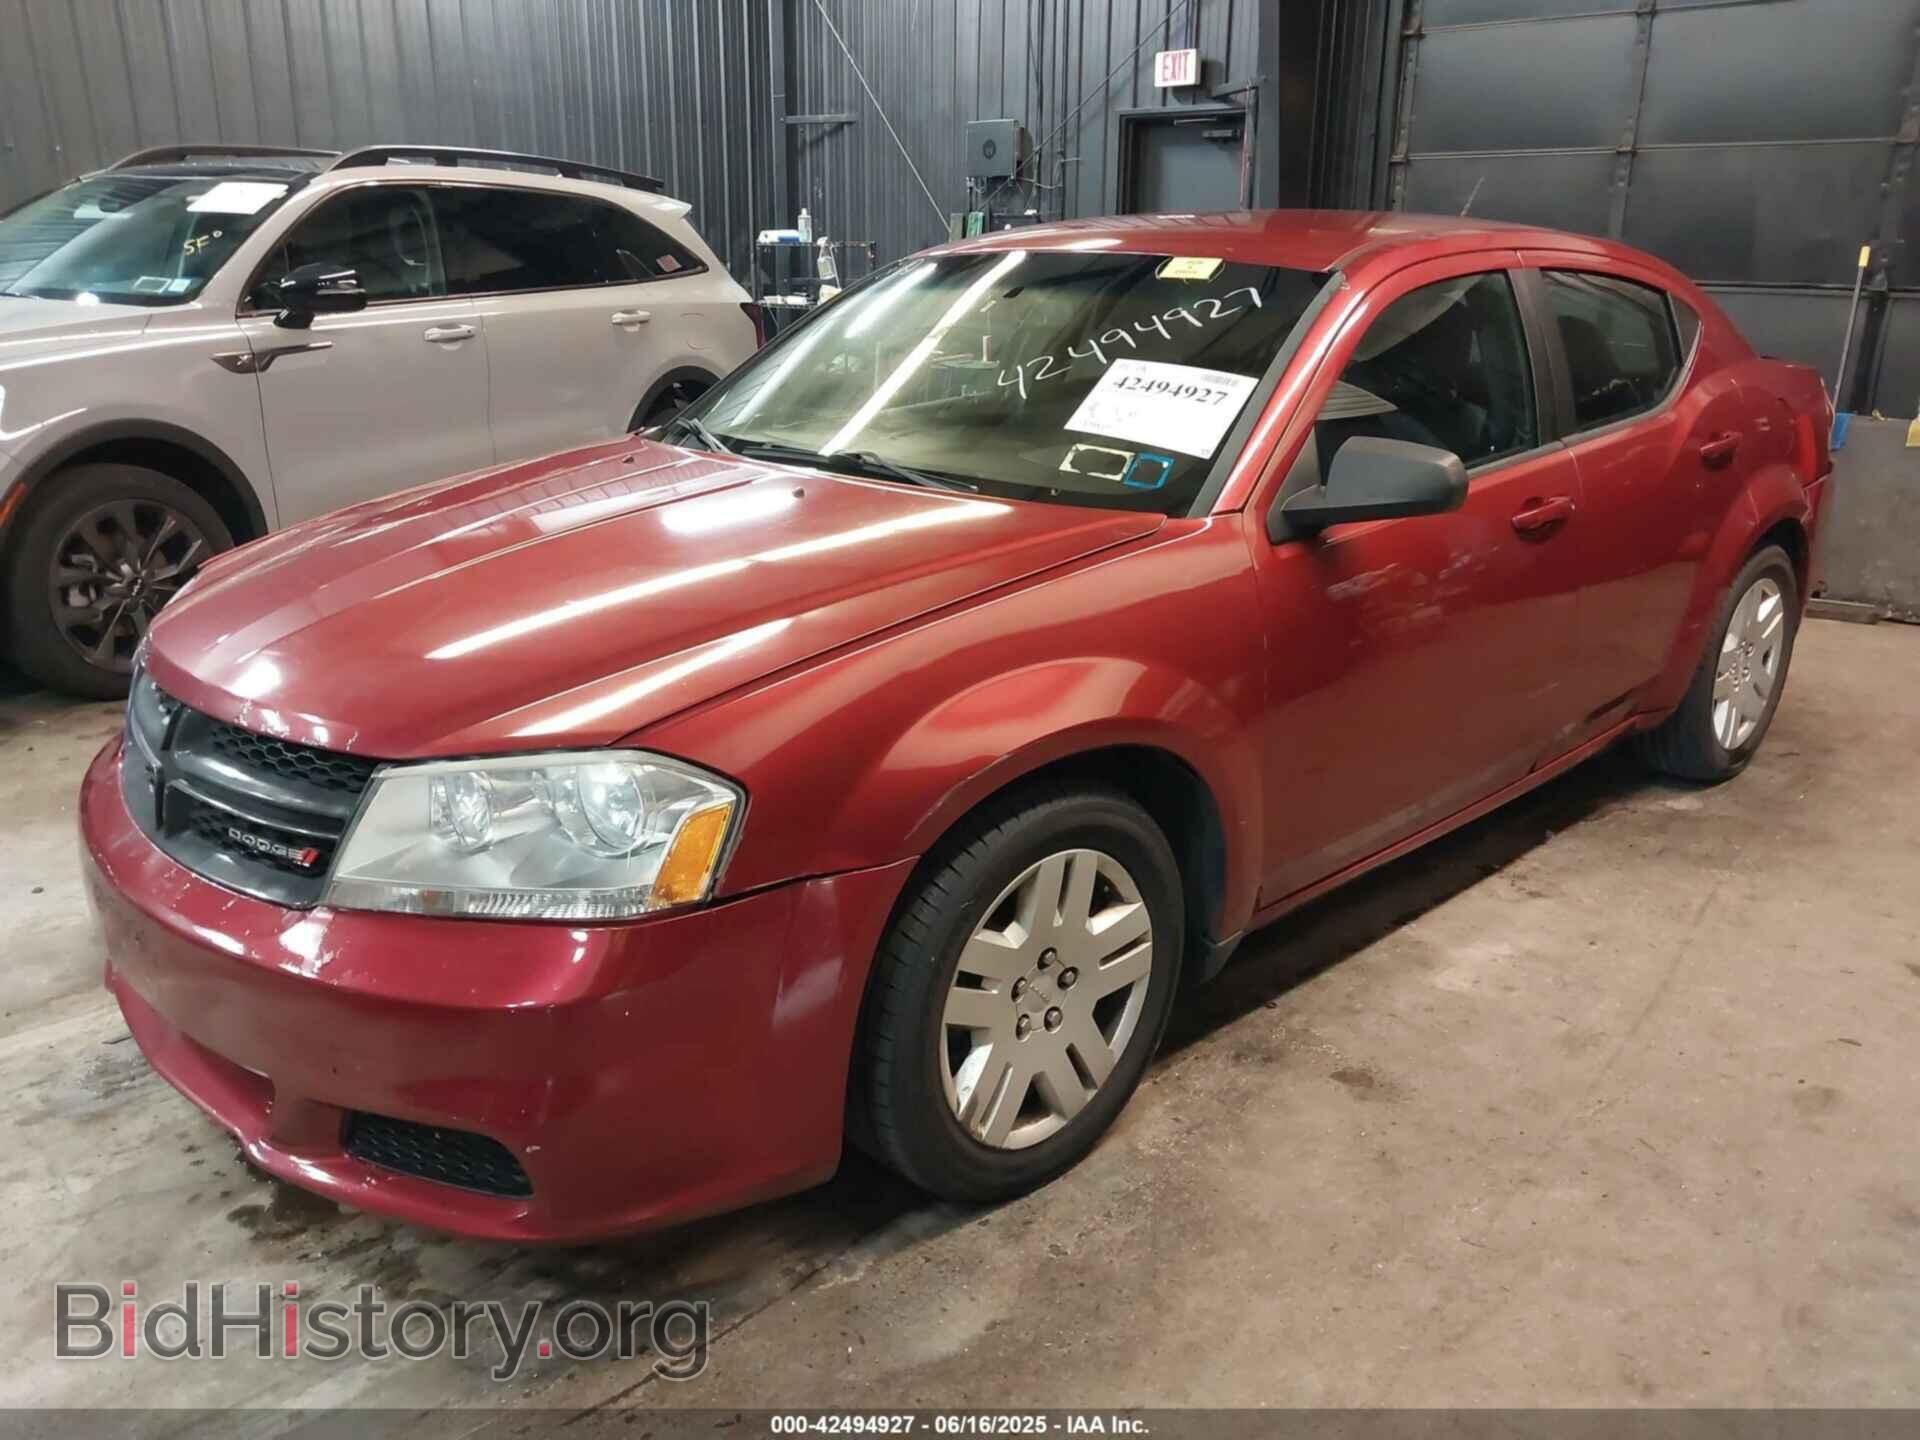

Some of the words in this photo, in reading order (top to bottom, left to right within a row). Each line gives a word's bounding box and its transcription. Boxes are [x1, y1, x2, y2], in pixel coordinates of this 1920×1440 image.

[1162, 51, 1191, 82] EXIT
[997, 287, 1262, 400] 42494927
[1113, 375, 1229, 406] 42494927
[228, 827, 304, 861] DODGE
